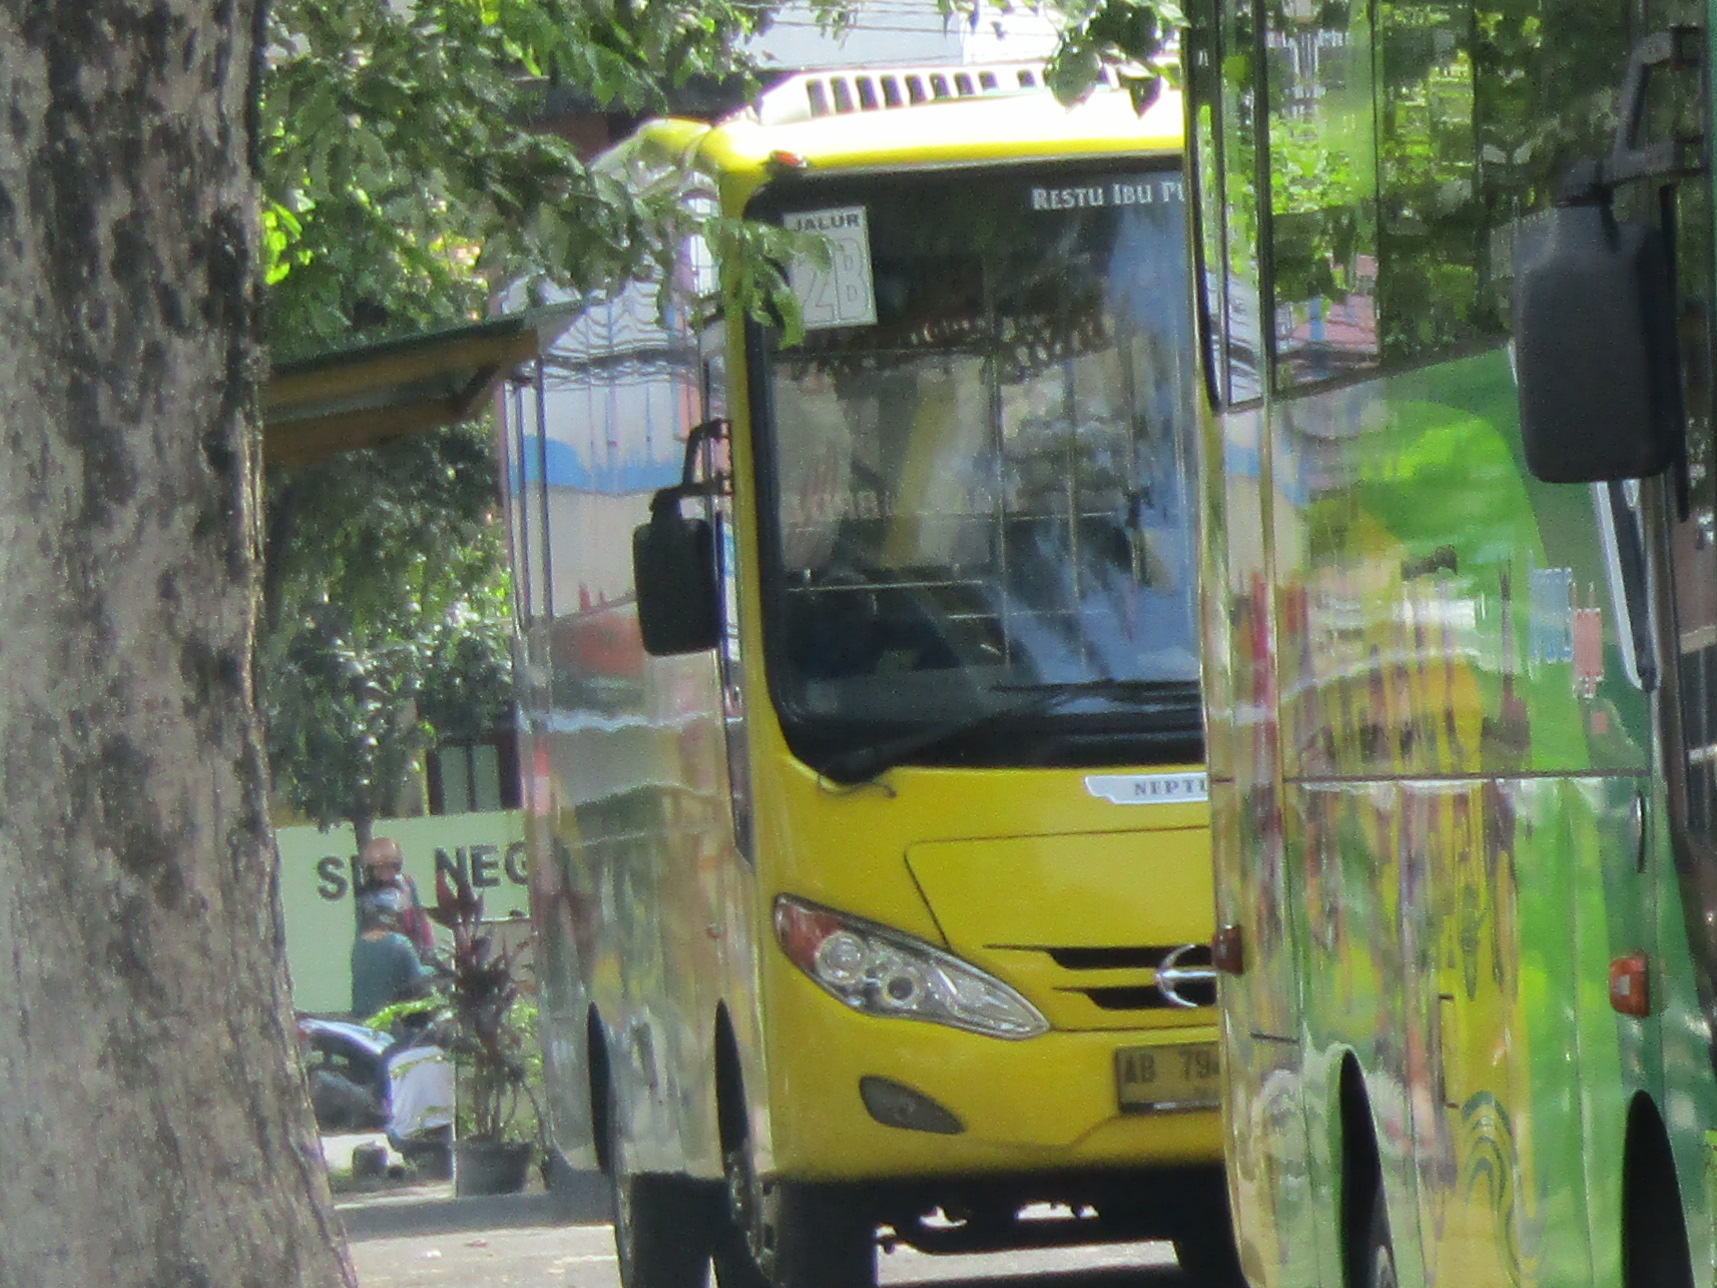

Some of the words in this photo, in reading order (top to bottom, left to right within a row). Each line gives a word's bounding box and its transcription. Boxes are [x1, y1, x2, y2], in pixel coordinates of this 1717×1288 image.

[1032, 185, 1104, 211] RESTU
[1112, 182, 1152, 206] IBU
[794, 212, 860, 232] JALUR
[1179, 1050, 1219, 1080] 79
